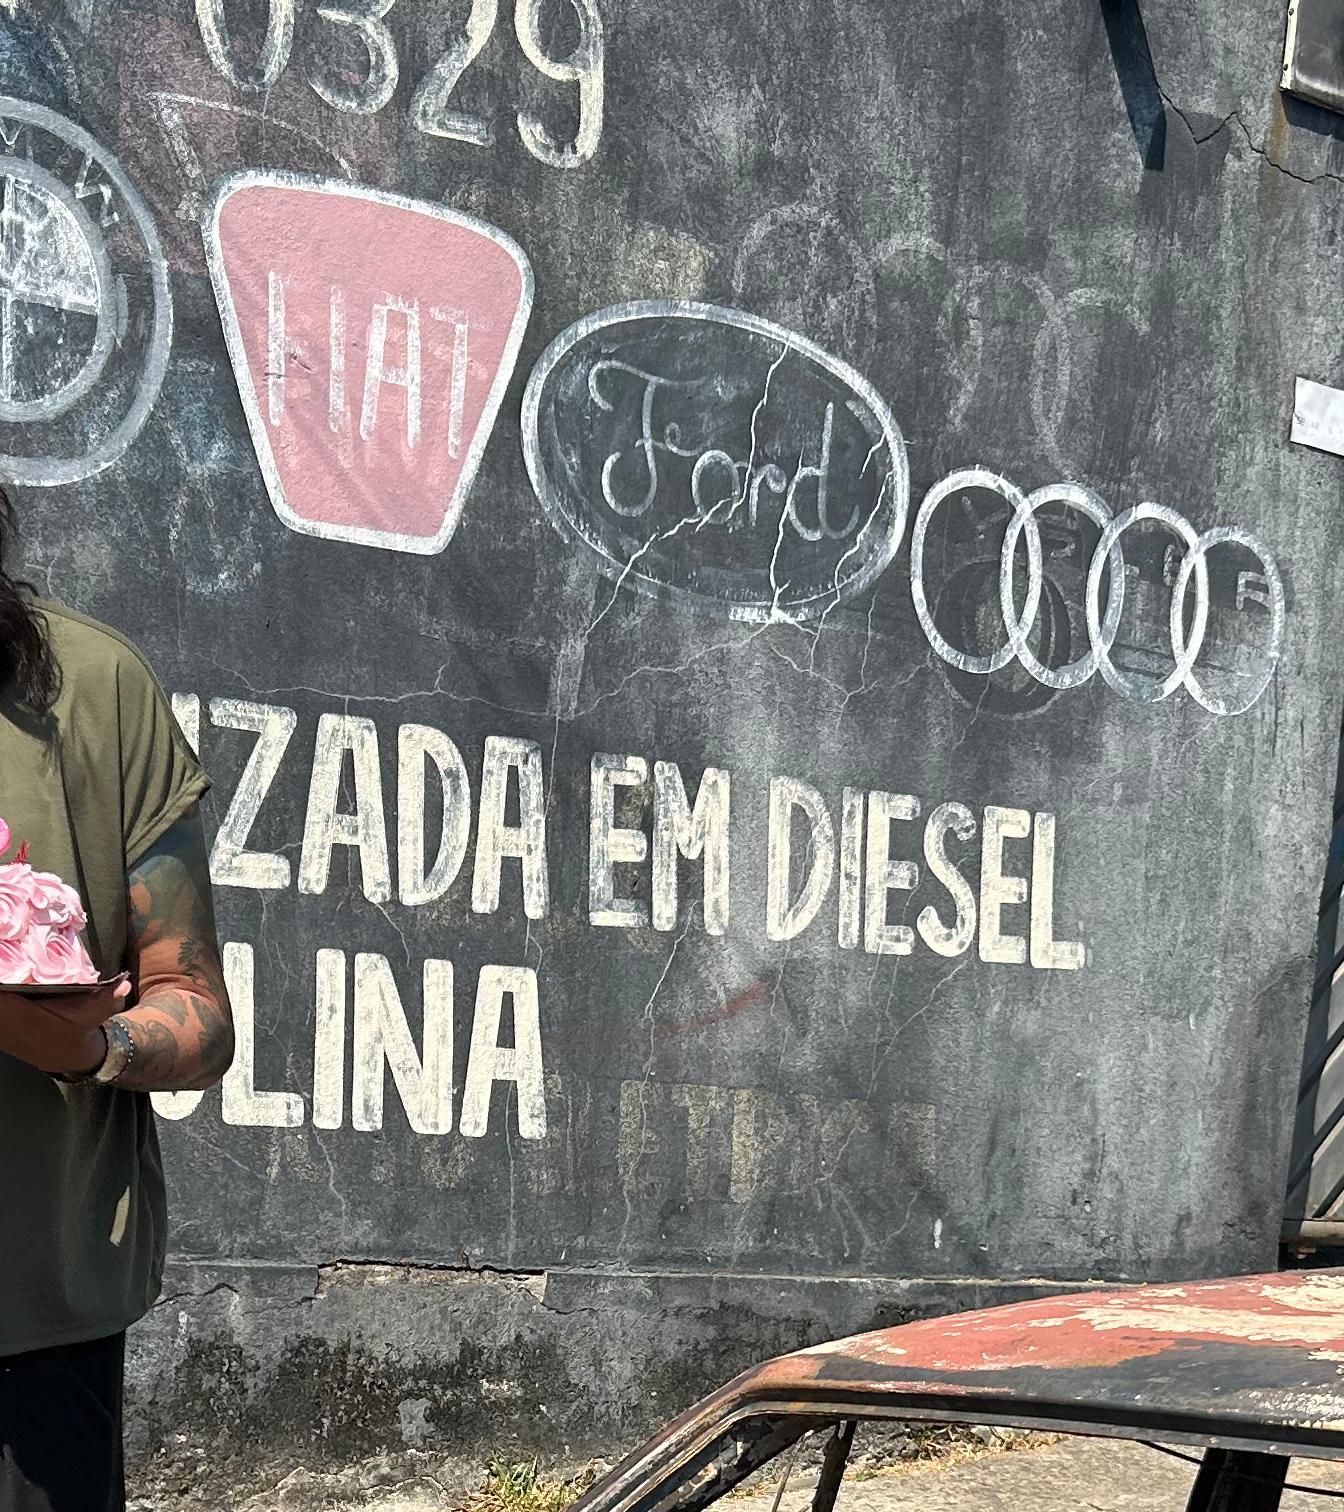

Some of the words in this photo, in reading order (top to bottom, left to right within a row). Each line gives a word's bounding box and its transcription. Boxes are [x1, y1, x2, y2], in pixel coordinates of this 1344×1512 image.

[586, 358, 859, 542] Ford
[588, 752, 731, 936] EM
[765, 775, 1086, 970] DIESEL
[150, 941, 547, 1138] LINA
